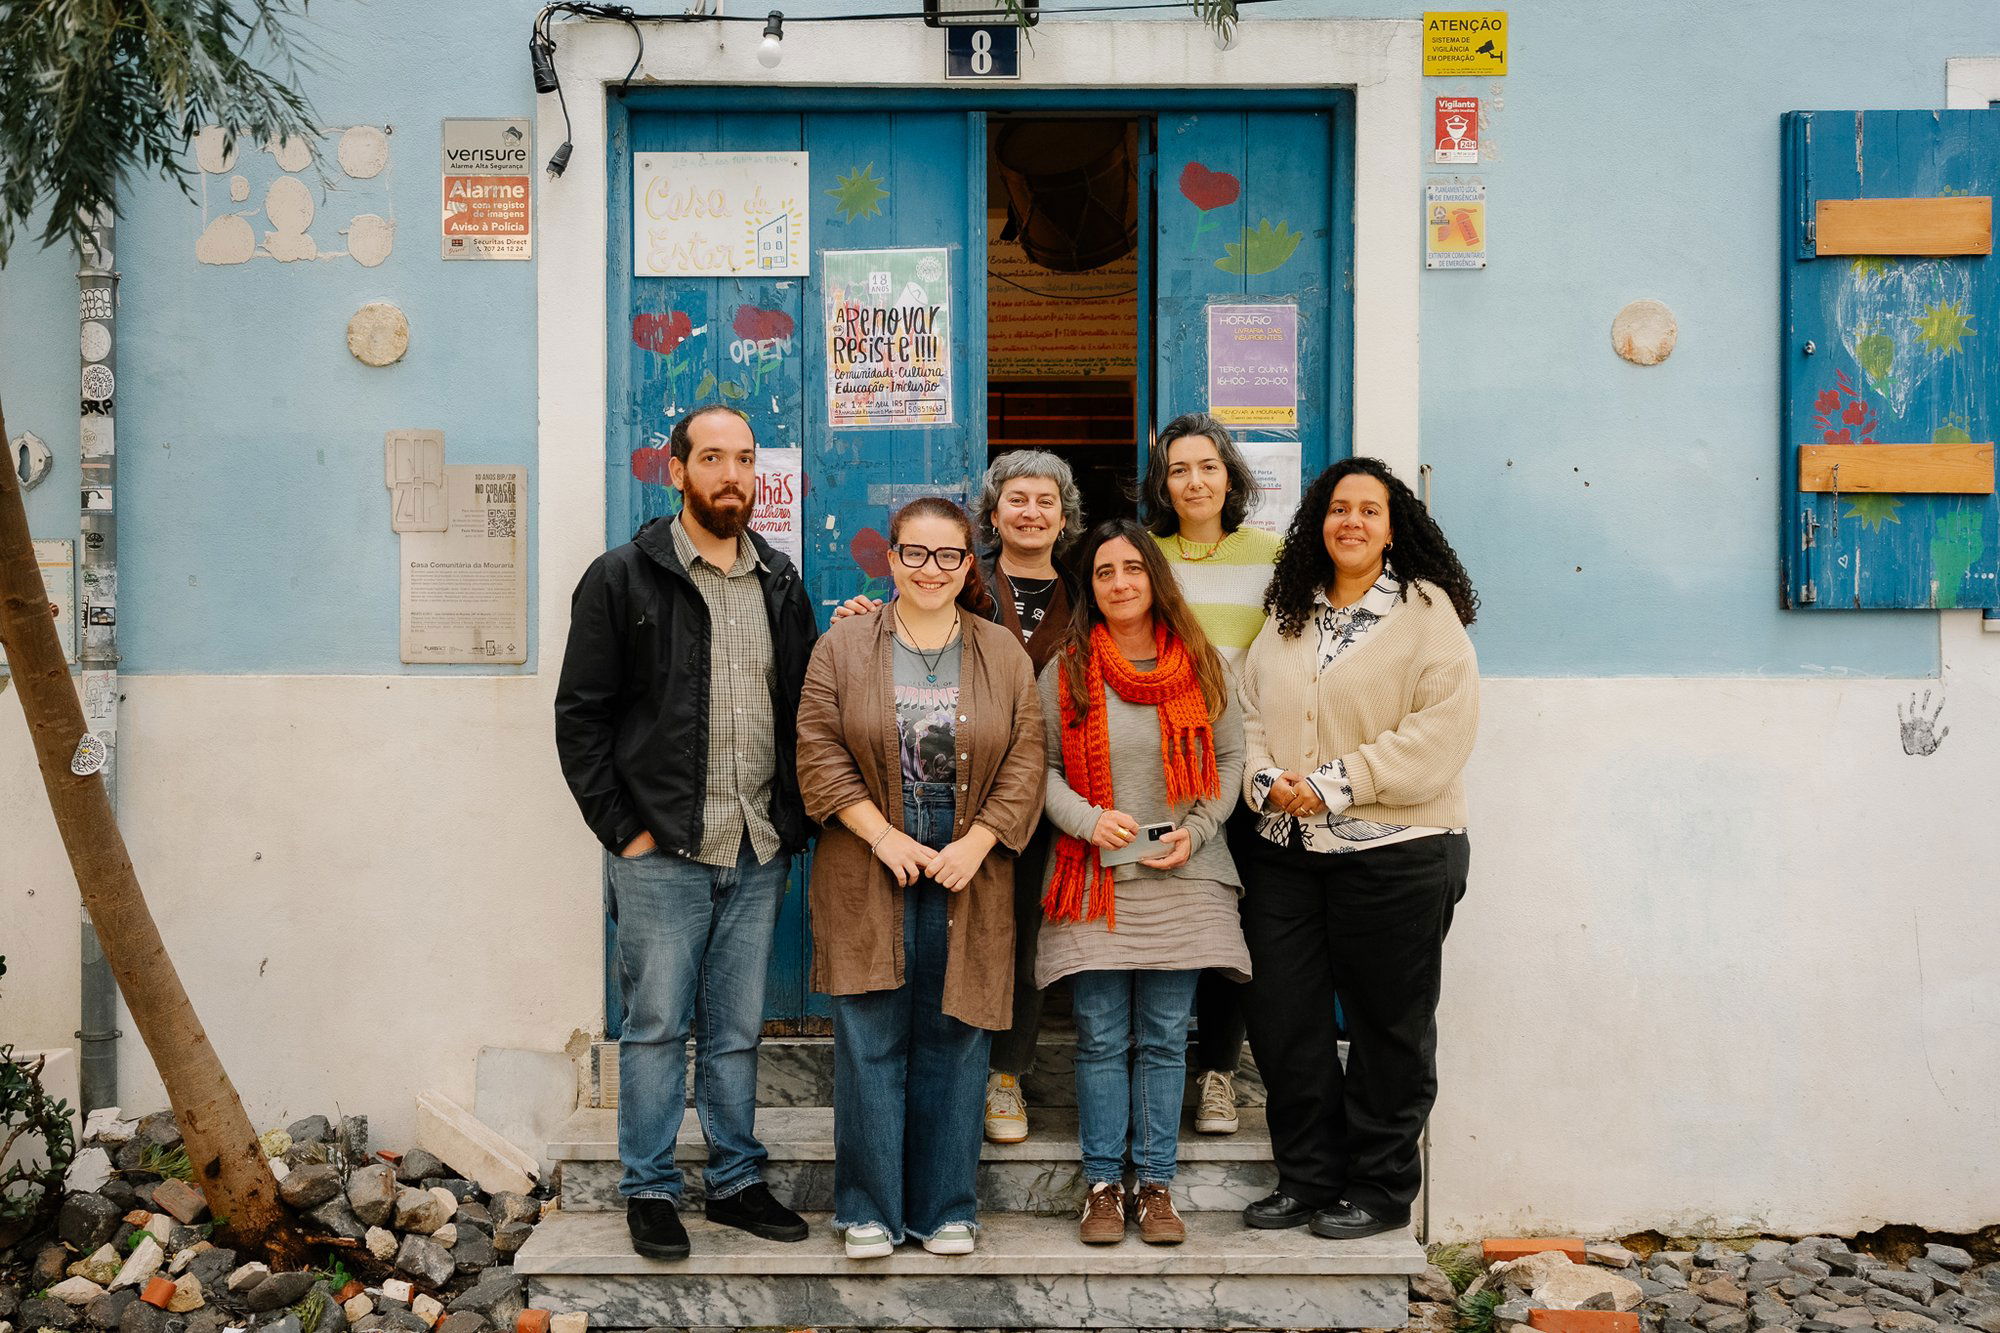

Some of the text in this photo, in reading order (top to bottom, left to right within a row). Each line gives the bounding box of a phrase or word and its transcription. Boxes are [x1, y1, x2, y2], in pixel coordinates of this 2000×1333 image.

[1429, 17, 1502, 33] ATENÇÃO
[971, 30, 992, 74] 8
[1439, 100, 1475, 109] Vigilante
[447, 149, 526, 161] verisure
[450, 180, 525, 198] Alarme
[494, 202, 525, 210] registo
[488, 210, 524, 219] imagens
[451, 222, 479, 231] Aviso
[492, 222, 524, 231] Polícia
[872, 274, 887, 284] 18
[836, 306, 940, 337] A Renovar
[1220, 314, 1272, 325] HORÁRIO
[729, 334, 792, 366] OPEN
[835, 366, 943, 380] Comunidade Cultura
[1219, 366, 1246, 375] TERÇA
[835, 380, 940, 395] Educação Inclusão
[81, 400, 113, 416] SRP
[486, 482, 516, 494] CORAÇÃO
[493, 494, 516, 503] CIDADE
